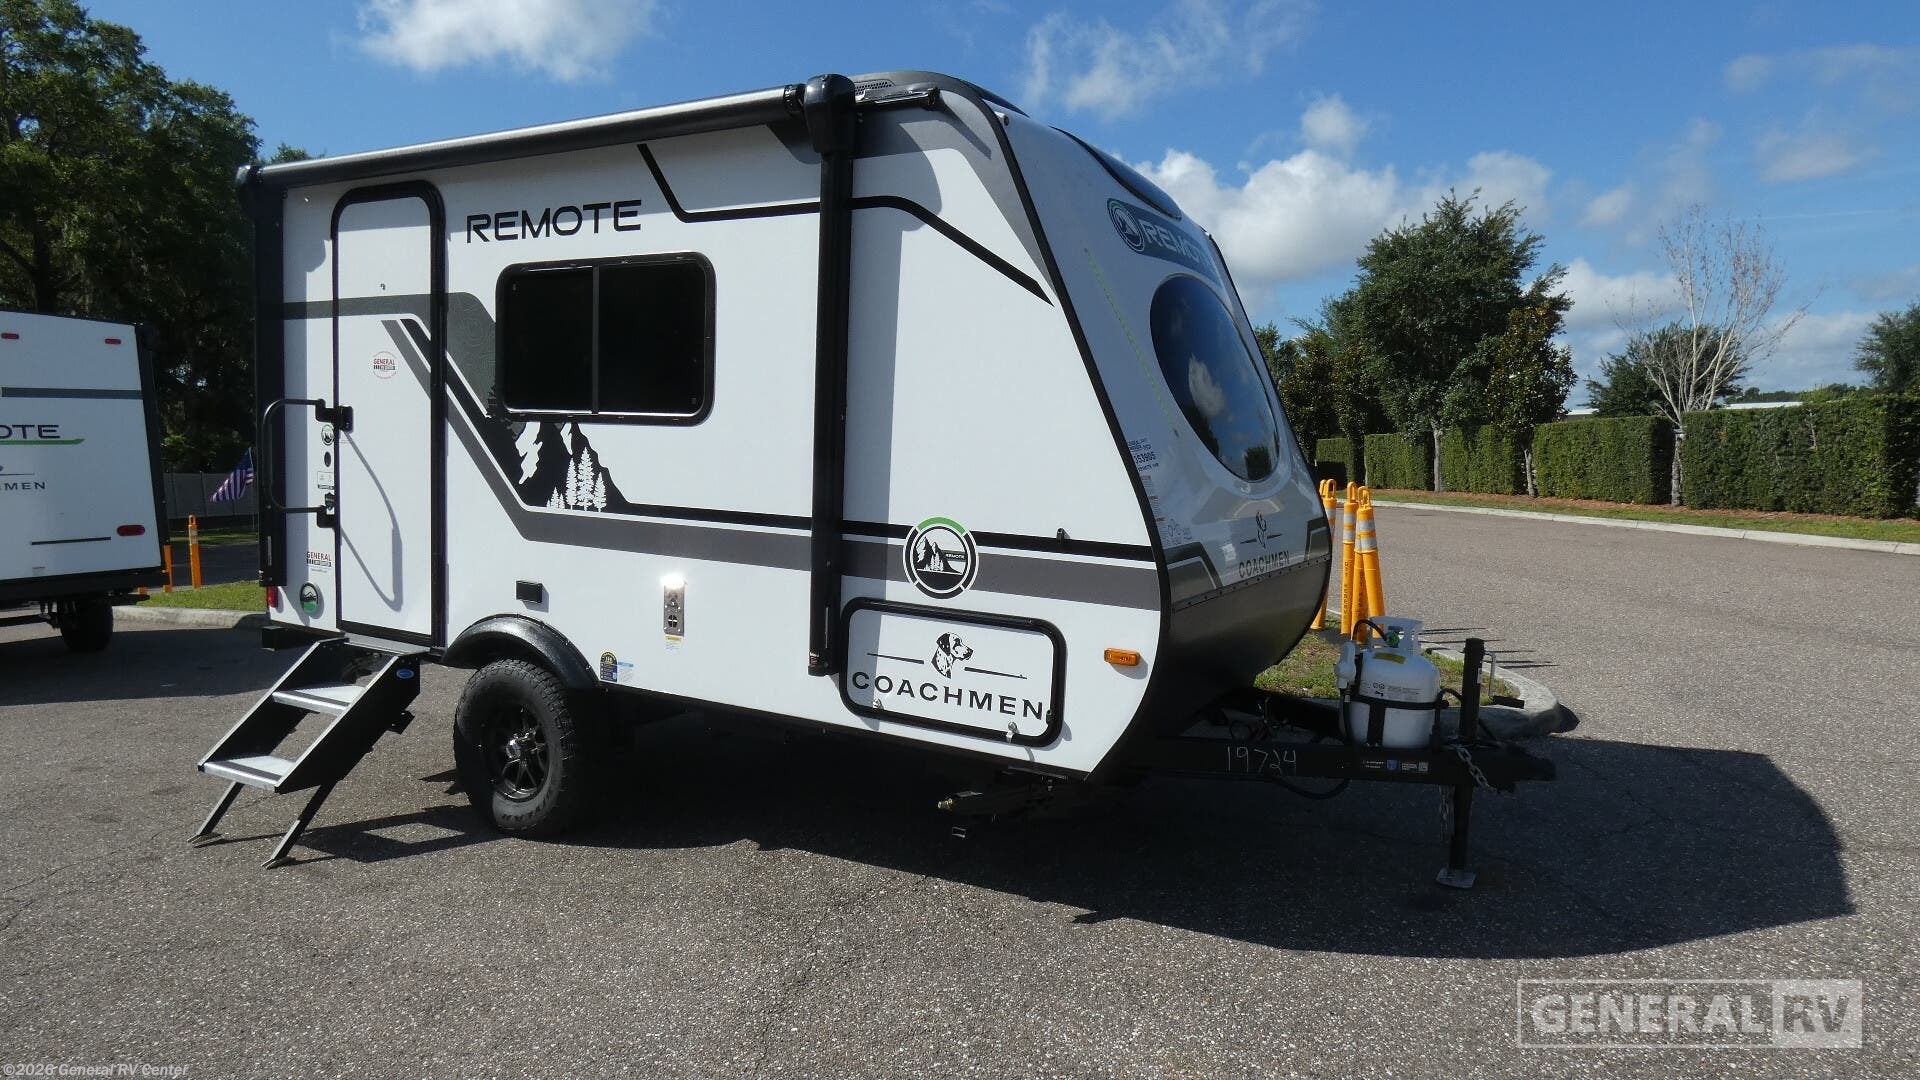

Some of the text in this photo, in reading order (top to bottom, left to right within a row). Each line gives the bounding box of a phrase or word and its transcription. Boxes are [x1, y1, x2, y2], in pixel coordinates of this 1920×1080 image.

[467, 200, 642, 244] REMOTE
[0, 482, 46, 491] MEN
[306, 551, 332, 561] GENERAL
[1239, 550, 1290, 578] COACHMEN
[852, 671, 1043, 720] COACHMEN
